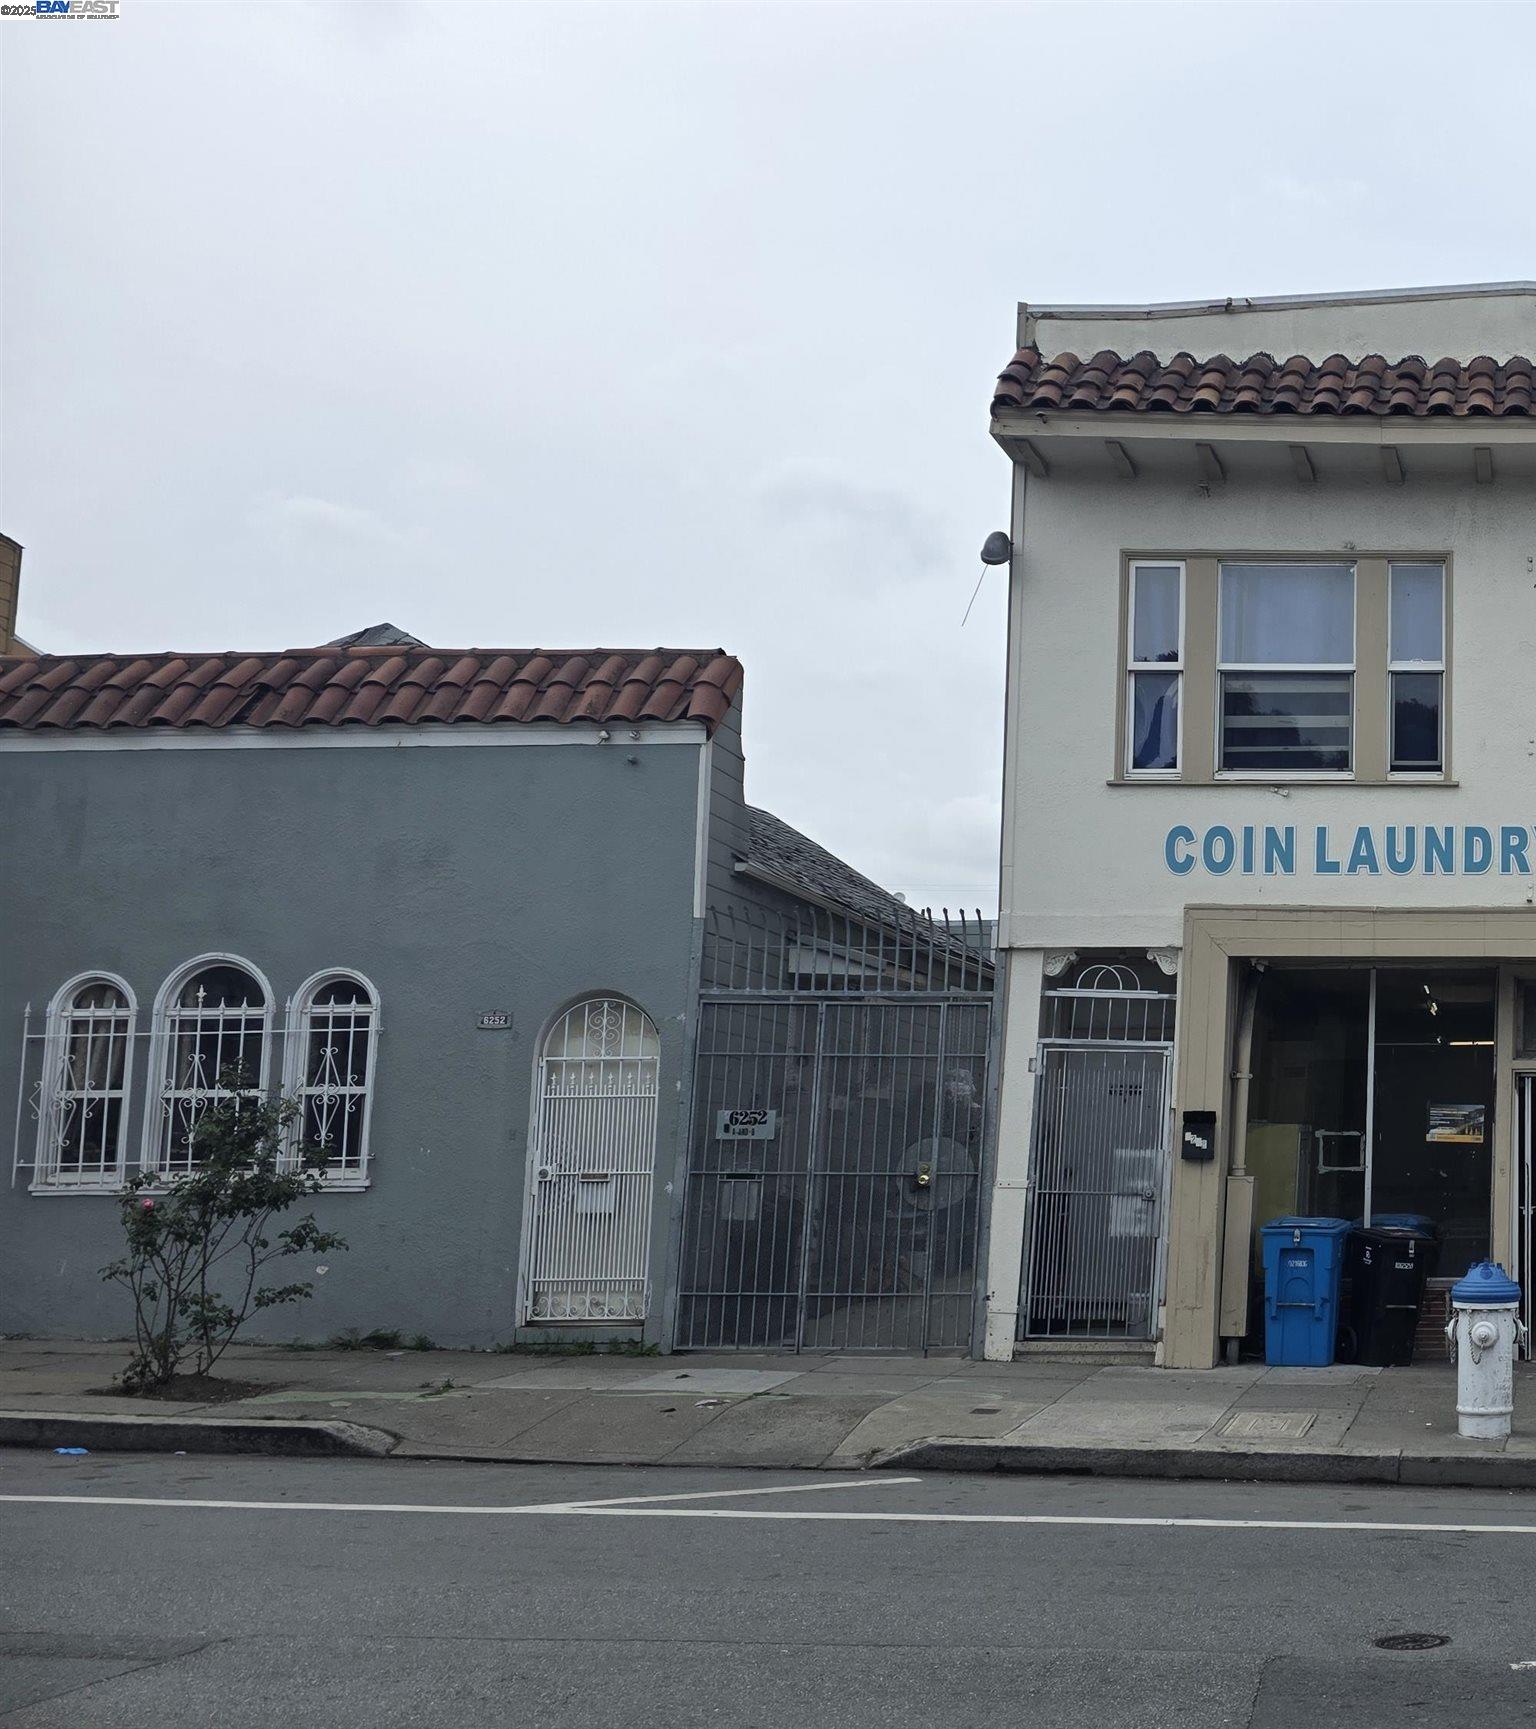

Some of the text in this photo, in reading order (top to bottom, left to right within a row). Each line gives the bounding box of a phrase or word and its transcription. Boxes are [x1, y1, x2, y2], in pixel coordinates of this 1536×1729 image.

[1164, 824, 1295, 875] COIN
[483, 1016, 506, 1025] 6252
[729, 1110, 768, 1126] 6252
